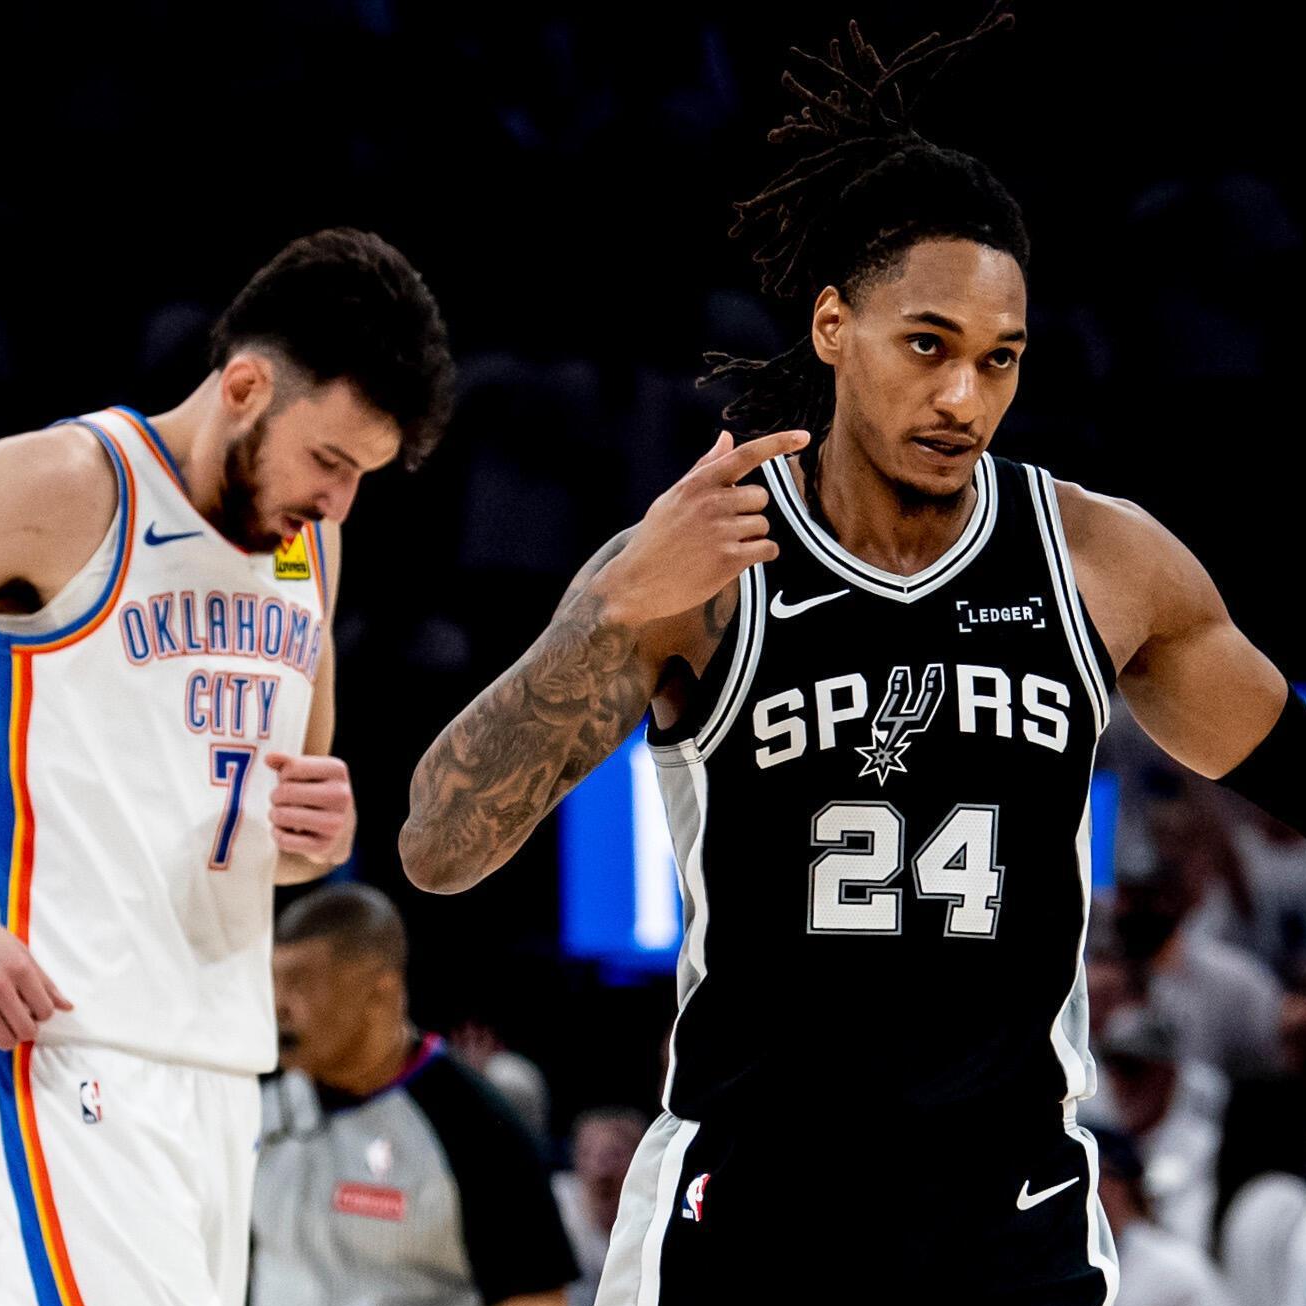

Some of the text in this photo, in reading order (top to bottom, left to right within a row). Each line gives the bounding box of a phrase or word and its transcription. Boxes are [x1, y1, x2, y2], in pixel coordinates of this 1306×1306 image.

[968, 606, 1034, 624] LEDGER
[184, 668, 281, 740] CITY
[752, 662, 1071, 787] SPURS
[207, 742, 258, 871] 7
[806, 800, 1006, 939] 24
